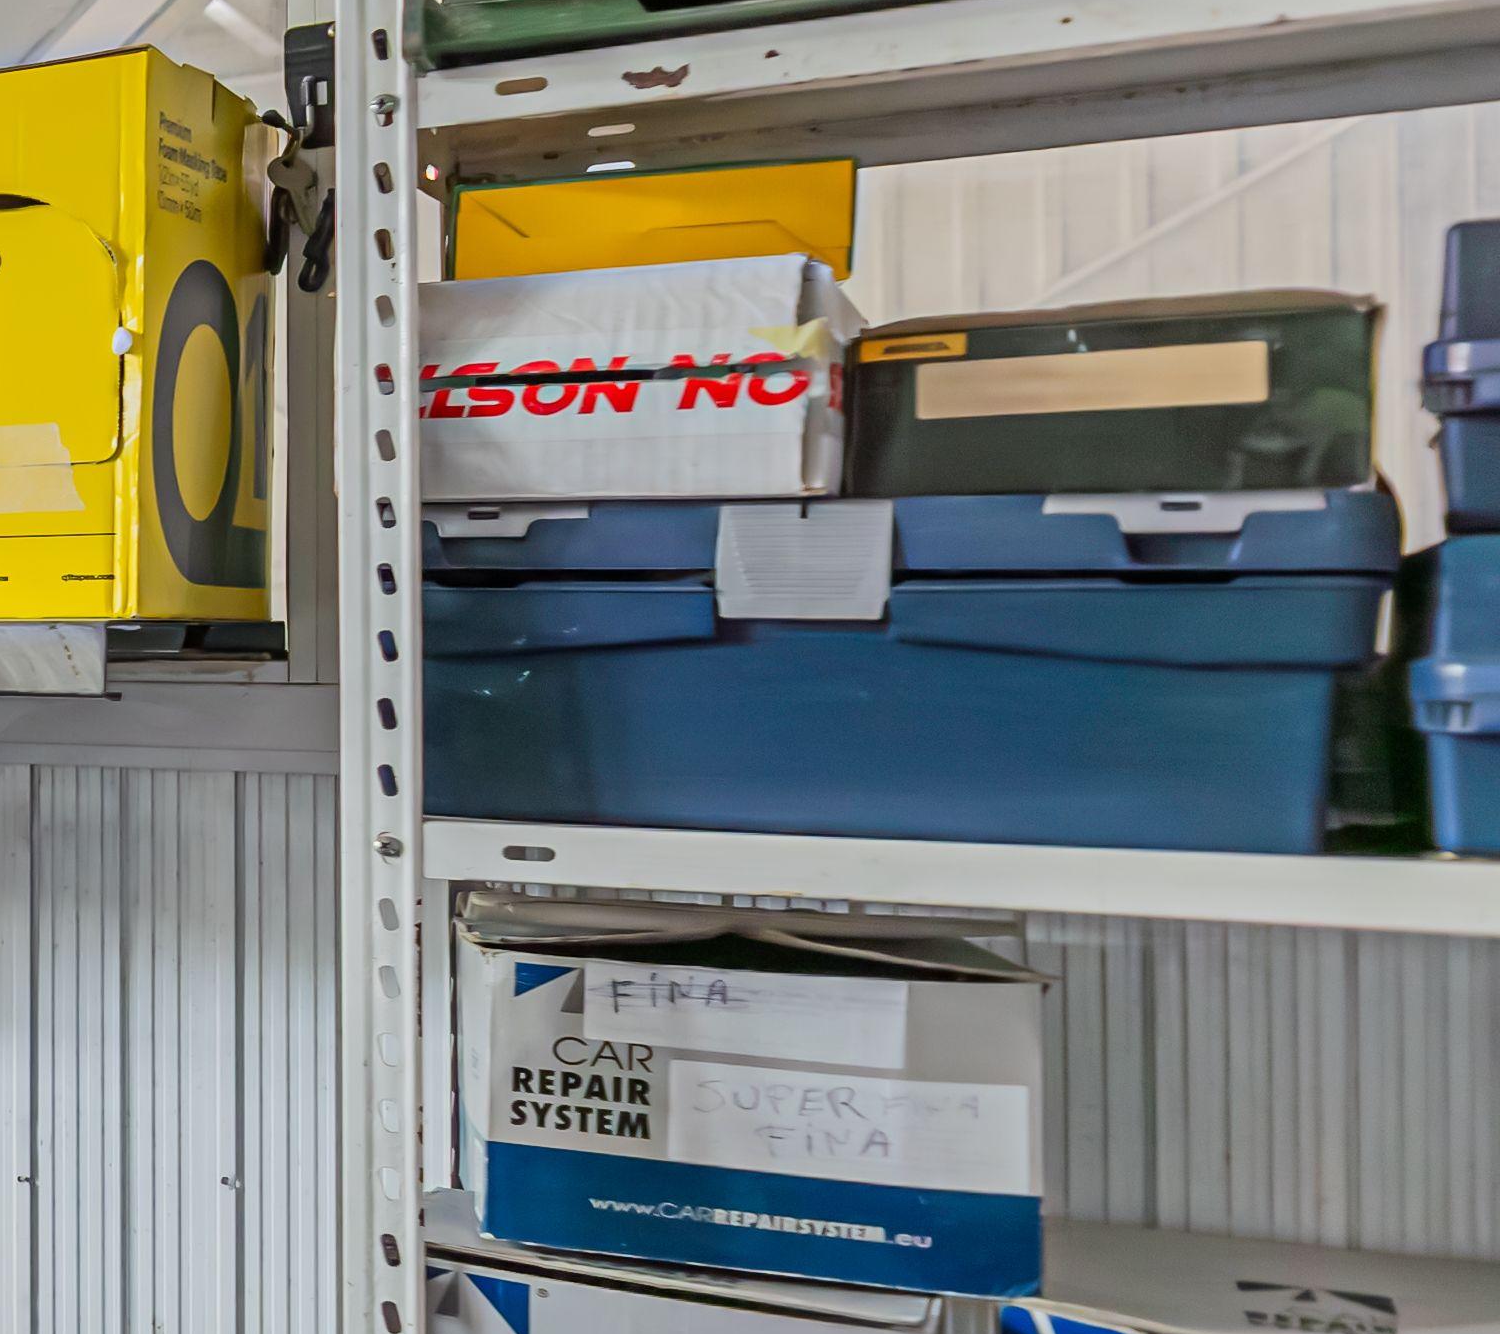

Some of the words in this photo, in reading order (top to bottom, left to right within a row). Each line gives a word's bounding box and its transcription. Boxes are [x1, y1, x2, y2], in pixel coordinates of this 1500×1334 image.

[553, 1035, 654, 1073] CAR
[512, 1067, 650, 1106] REPAIR
[510, 1100, 651, 1140] SYSTEM
